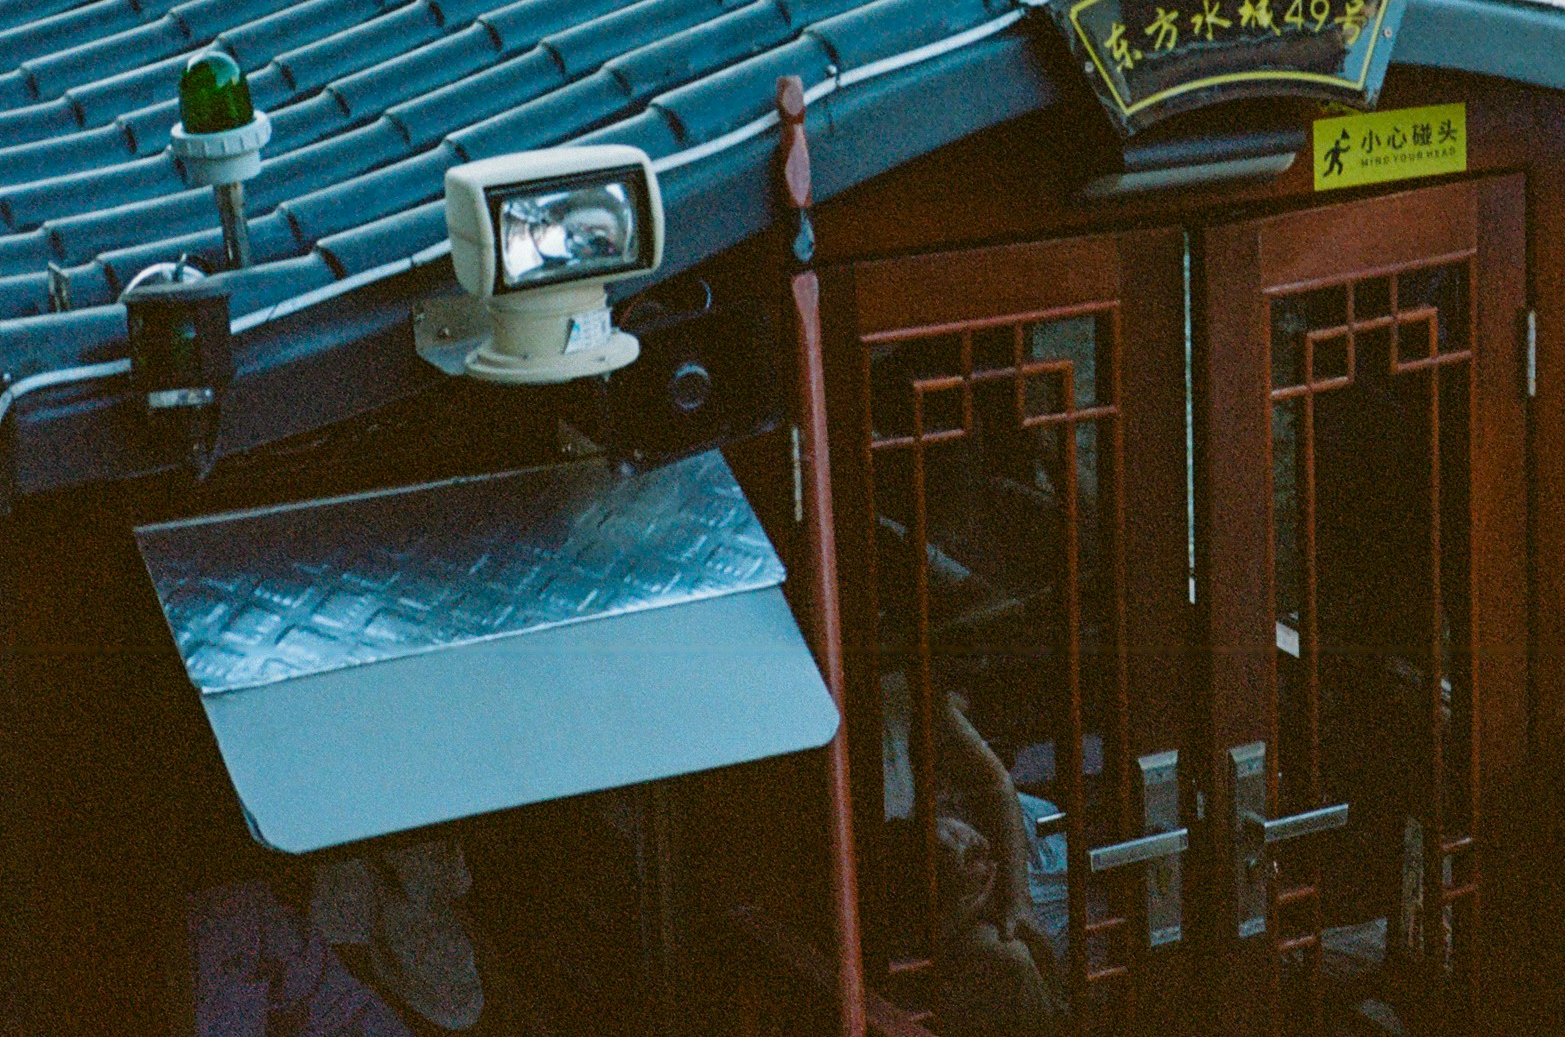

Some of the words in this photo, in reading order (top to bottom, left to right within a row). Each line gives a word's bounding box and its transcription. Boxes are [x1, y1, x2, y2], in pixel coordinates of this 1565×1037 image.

[1361, 120, 1457, 153] 小心碰头
[1393, 152, 1424, 164] YOUR
[1426, 146, 1456, 160] HEAD
